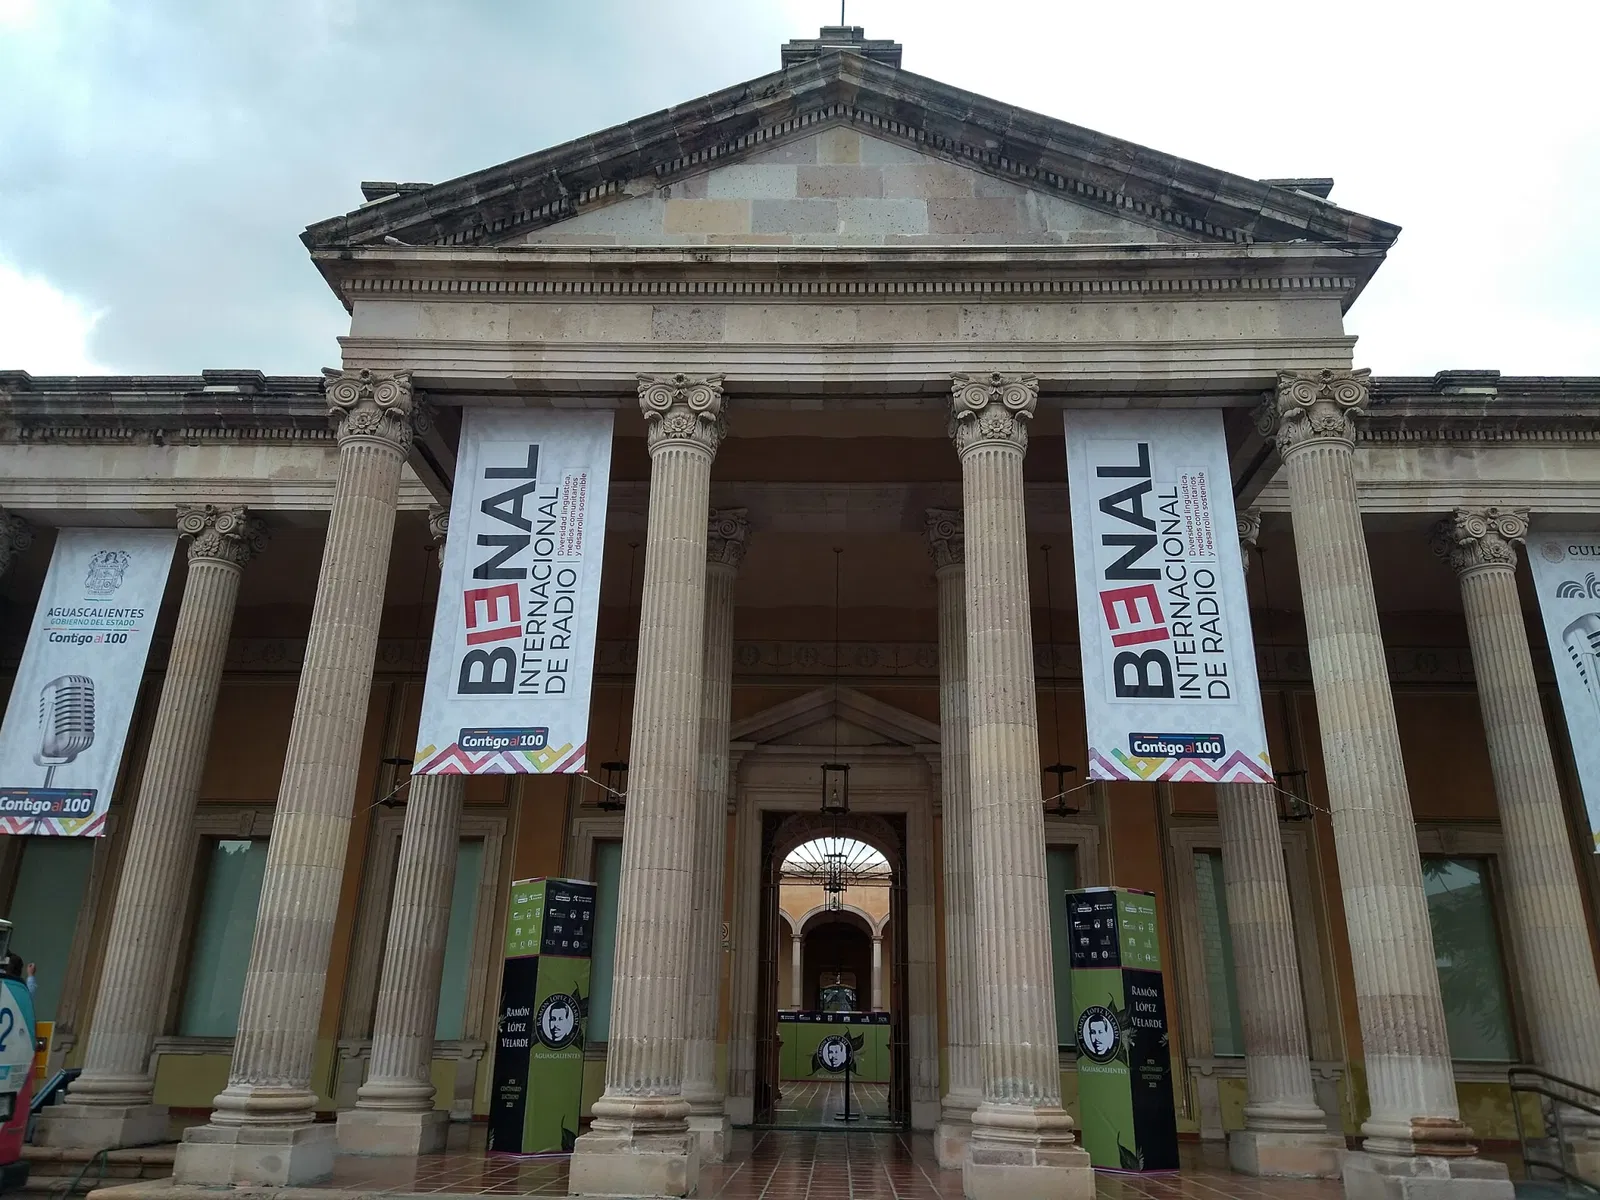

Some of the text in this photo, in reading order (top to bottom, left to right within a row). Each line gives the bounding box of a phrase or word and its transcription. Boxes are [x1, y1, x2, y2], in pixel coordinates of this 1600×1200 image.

[570, 477, 579, 527] comunitarios
[579, 473, 587, 511] sostenible
[1198, 472, 1208, 510] sostenible
[1190, 476, 1204, 556] medios comunitarios
[557, 516, 567, 556] Diversidad
[575, 512, 584, 550] desarrollo
[1186, 516, 1196, 556] Diversidad
[1202, 511, 1213, 550] desarrollo
[518, 487, 559, 694] INTERNACIONAL
[1159, 486, 1202, 699] INTERNACIONAL
[47, 607, 145, 618] AGUASCALIENTES
[49, 632, 128, 645] Contigo al 100
[545, 568, 577, 694] DE RADIO
[1193, 569, 1231, 699] DE RADIO
[462, 735, 544, 749] Contigo al 100
[1133, 740, 1221, 756] Contigo al 100
[51, 798, 64, 811] al
[63, 798, 91, 812] 100
[1131, 985, 1158, 997] RAMÓN
[506, 1006, 530, 1017] RAMÓN
[1135, 1001, 1156, 1013] LÓPEZ
[507, 1022, 527, 1032] LÓPEZ
[1131, 1016, 1163, 1028] VELARDE
[501, 1038, 529, 1048] VELARDE
[1081, 1066, 1127, 1074] AGUASCALIENTES
